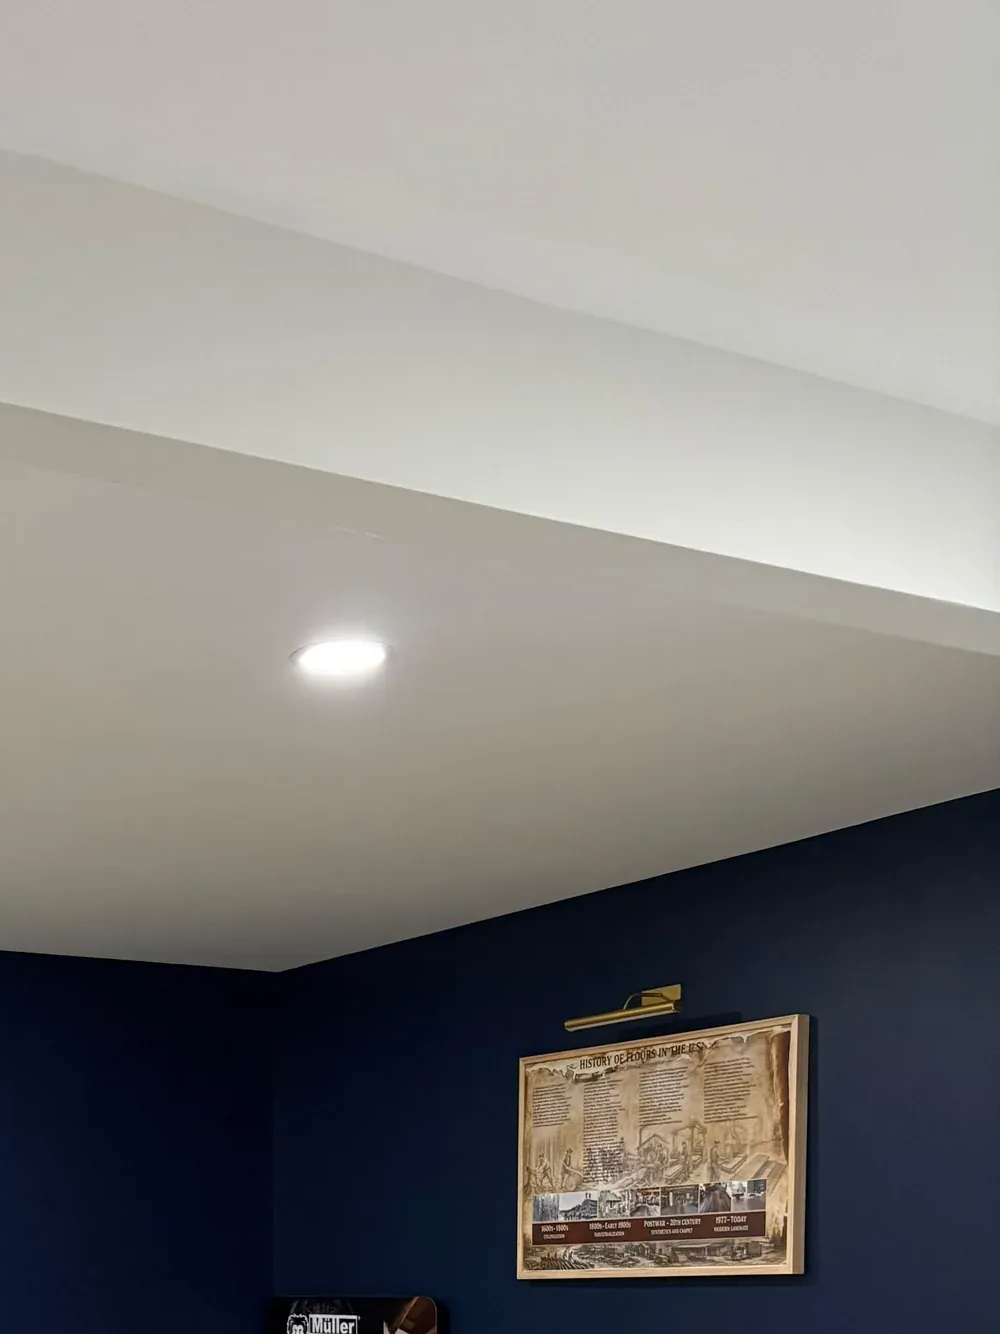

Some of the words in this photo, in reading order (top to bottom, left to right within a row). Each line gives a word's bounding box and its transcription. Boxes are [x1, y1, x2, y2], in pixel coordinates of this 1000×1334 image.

[580, 1056, 612, 1069] HISTORY
[624, 1049, 656, 1062] FLOORS
[311, 1317, 355, 1334] Müller
